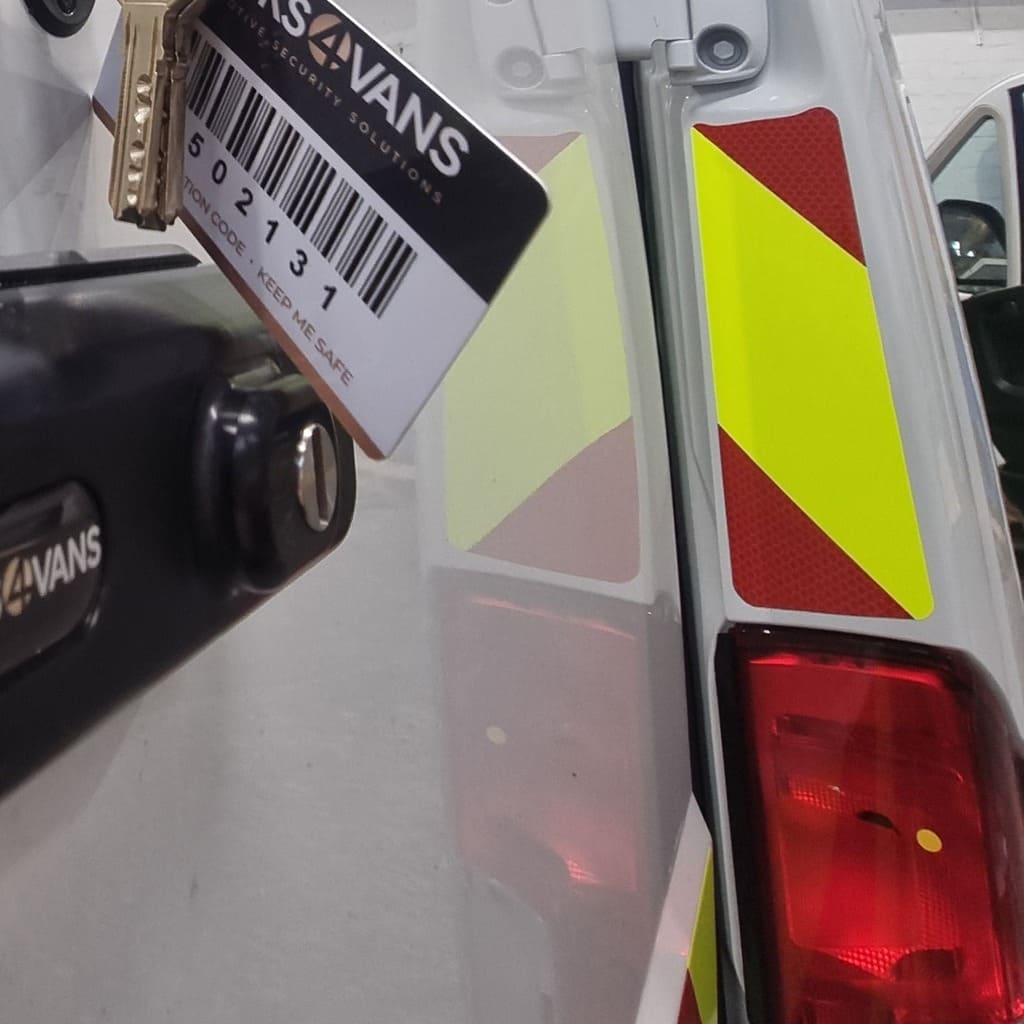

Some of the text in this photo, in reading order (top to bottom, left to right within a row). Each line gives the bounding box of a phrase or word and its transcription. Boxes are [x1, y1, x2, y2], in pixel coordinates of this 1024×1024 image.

[271, 39, 342, 107] SECURITY
[348, 111, 443, 204] SOLUTIONS
[210, 210, 247, 257] CODE
[257, 266, 293, 310] KEEP
[292, 310, 316, 342] ME
[314, 337, 354, 387] SAFE
